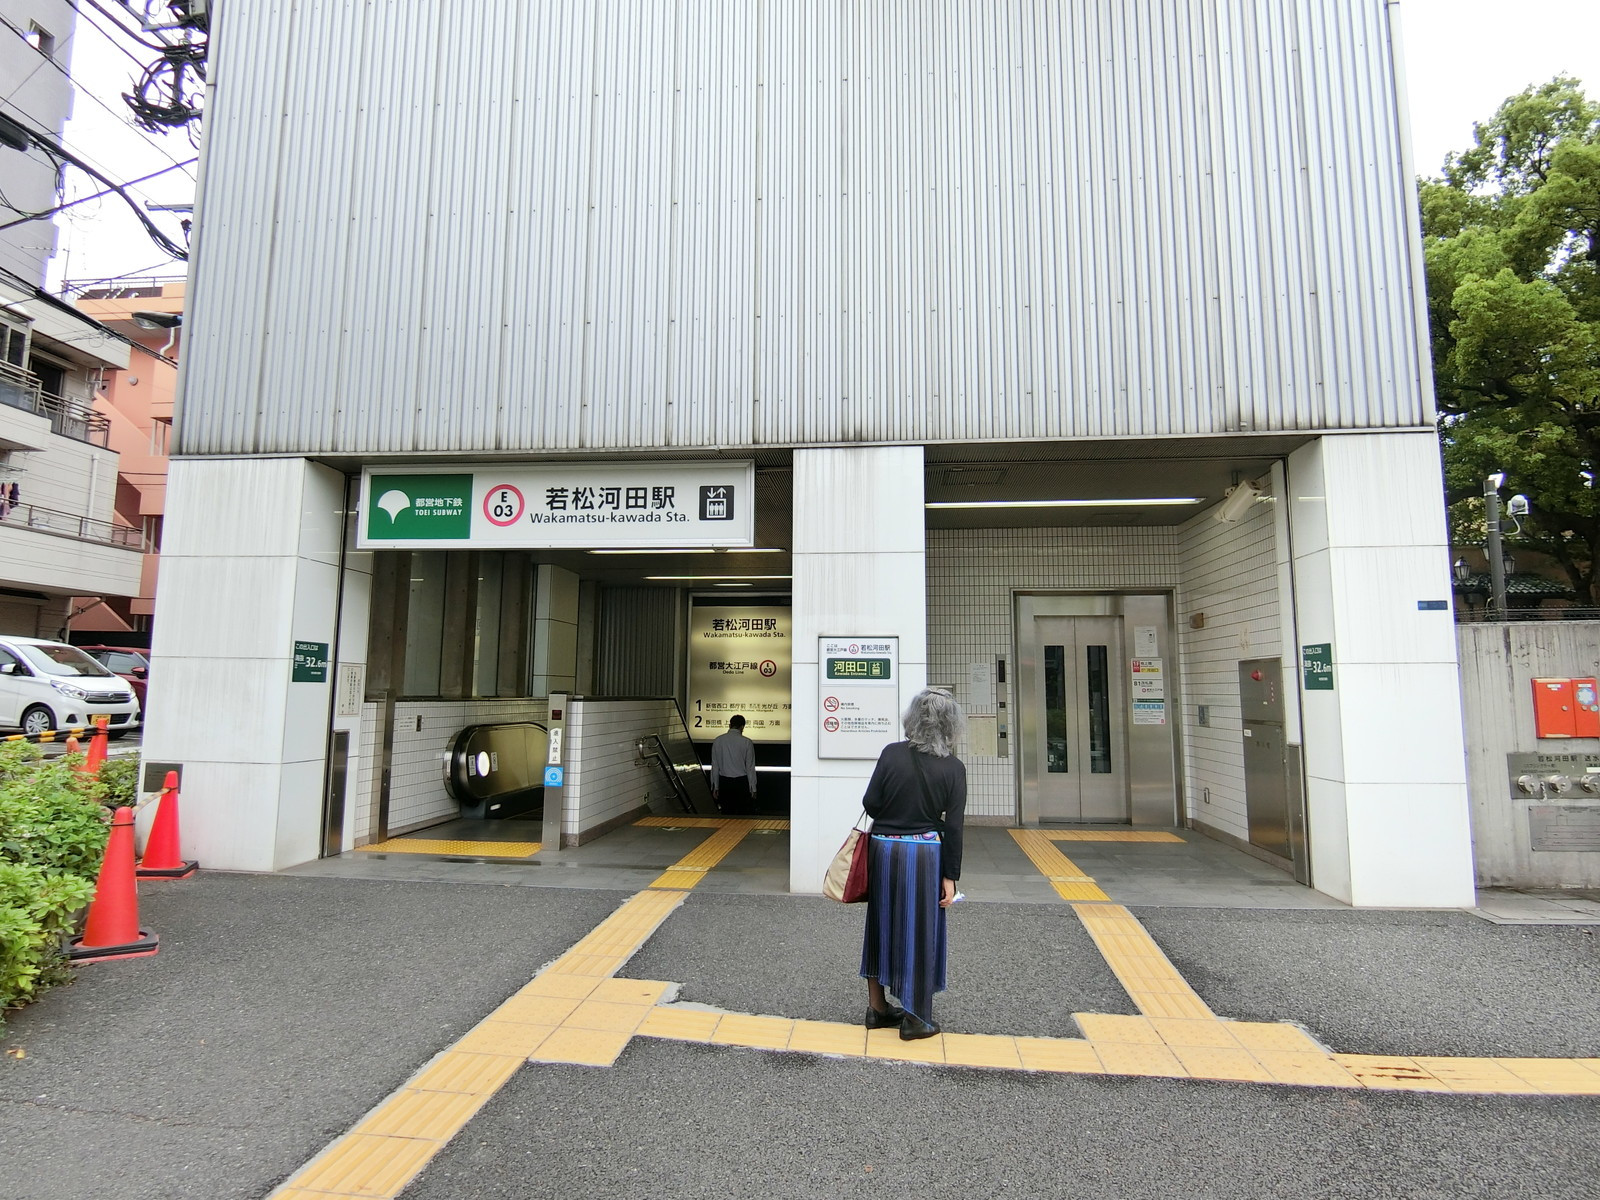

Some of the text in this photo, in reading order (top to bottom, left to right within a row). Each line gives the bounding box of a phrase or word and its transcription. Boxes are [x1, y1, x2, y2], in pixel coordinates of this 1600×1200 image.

[415, 497, 463, 507] 都営地下鉄
[500, 492, 508, 502] E
[545, 486, 675, 511] 若松河田駅
[494, 504, 514, 518] 03
[530, 512, 690, 524] Wakamatsu-kawada Sta.
[712, 618, 777, 631] 若松河田駅
[305, 656, 327, 668] 32.6m
[710, 662, 758, 670] 都営大江戸線
[834, 661, 867, 672] 河田口
[1312, 661, 1332, 673] 32.6m
[696, 700, 702, 711] 1
[694, 716, 702, 728] 2
